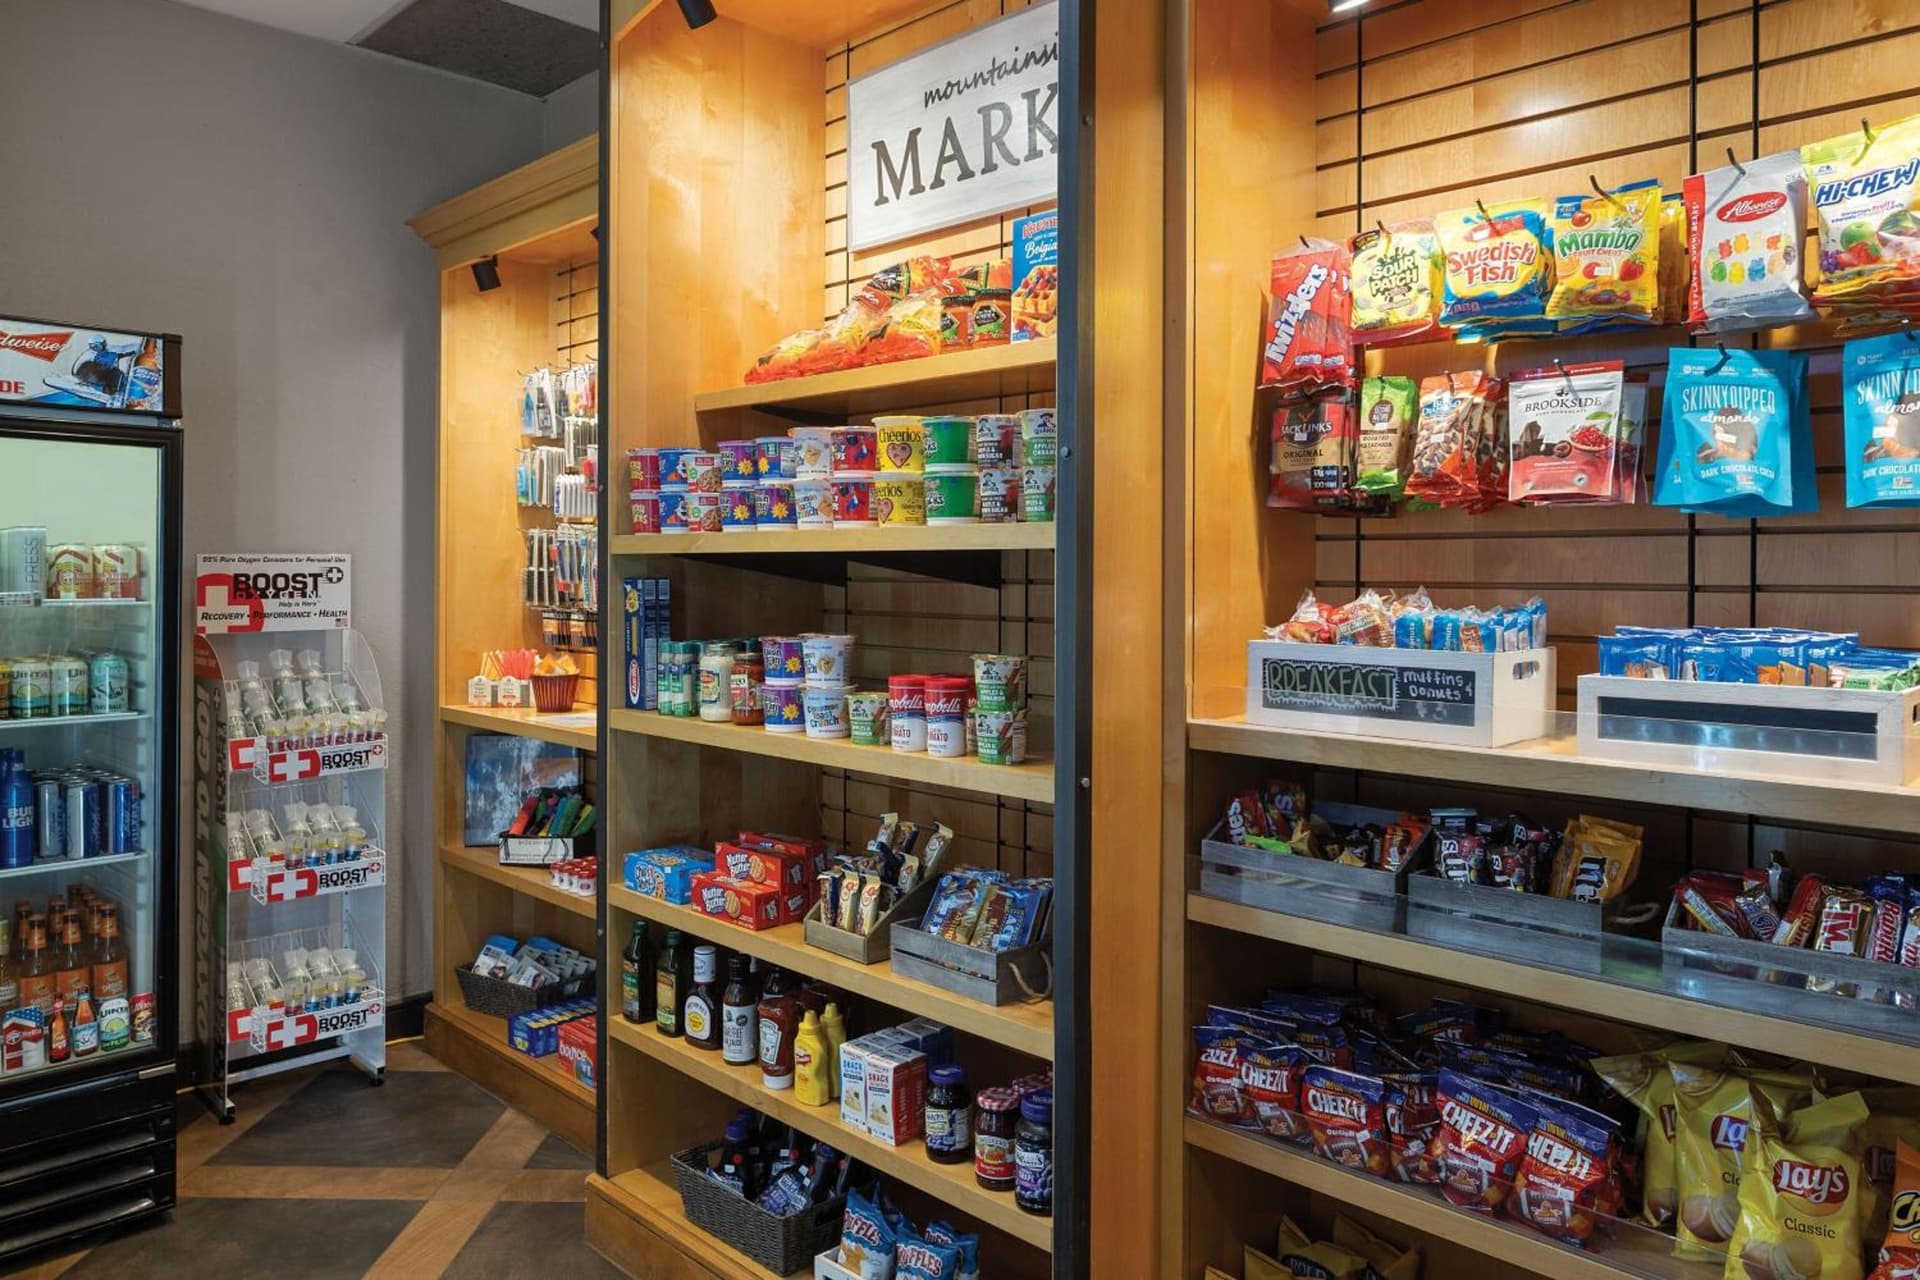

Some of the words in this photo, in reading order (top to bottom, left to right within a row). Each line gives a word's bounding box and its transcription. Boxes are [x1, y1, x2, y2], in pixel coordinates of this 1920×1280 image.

[1814, 157, 1920, 208] HI-CHEW
[1558, 231, 1642, 258] Mamba
[1371, 255, 1416, 279] SOUR
[1448, 243, 1536, 274] Swedish
[1369, 266, 1419, 298] PATCH
[1465, 263, 1517, 285] Fish
[1525, 396, 1603, 413] BROOKSIDE
[1682, 384, 1776, 415] SKINNYDIPPED
[878, 427, 921, 443] Cheerios
[233, 573, 323, 598] BOOST
[201, 612, 246, 621] RECOVERY
[252, 610, 312, 620] PERFORMANCE
[318, 609, 348, 618] HEALTH
[1269, 662, 1395, 705] BREAKFAST
[1409, 684, 1462, 700] Donuts
[322, 749, 372, 767] BOOST
[319, 867, 369, 885] BOOST
[319, 1010, 369, 1029] BOOST
[1778, 1161, 1846, 1203] Lay's
[1783, 1217, 1836, 1240] Classic
